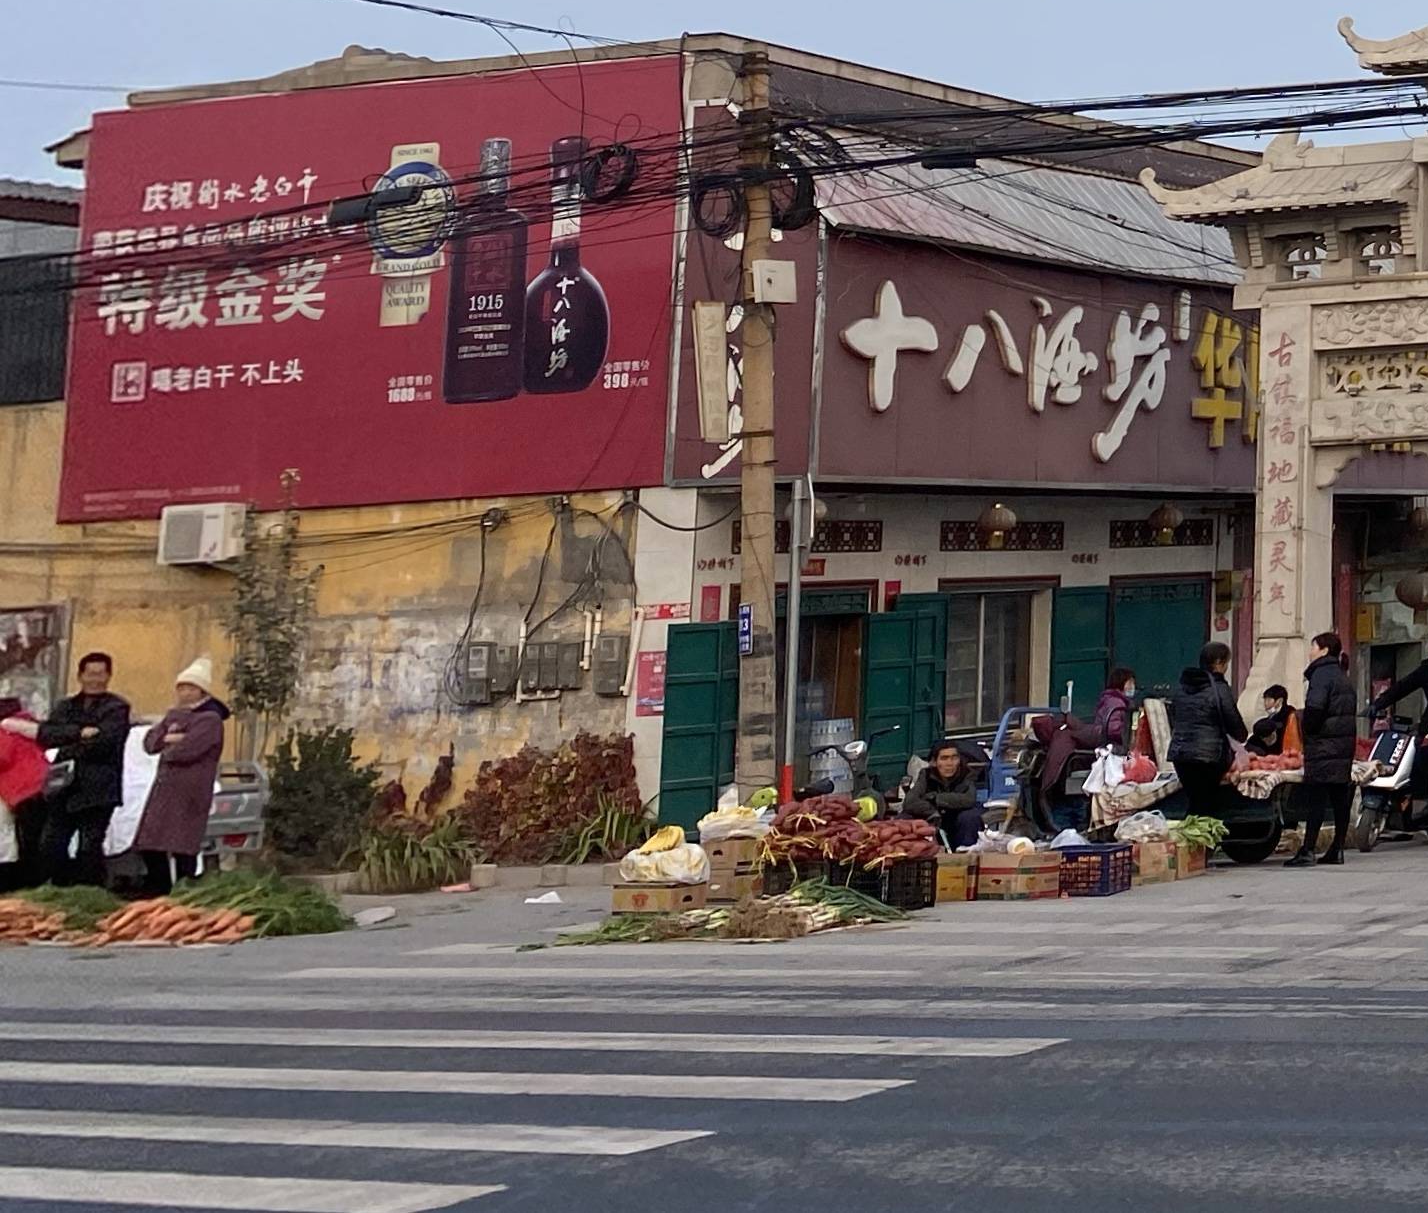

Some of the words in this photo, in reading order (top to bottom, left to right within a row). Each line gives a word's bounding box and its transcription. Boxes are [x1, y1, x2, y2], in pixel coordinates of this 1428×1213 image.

[385, 296, 425, 308] AWARD
[468, 294, 504, 312] 1915
[544, 276, 577, 378] 十八酒坊
[239, 358, 305, 387] 不上头
[840, 279, 1172, 464] 十八酒坊
